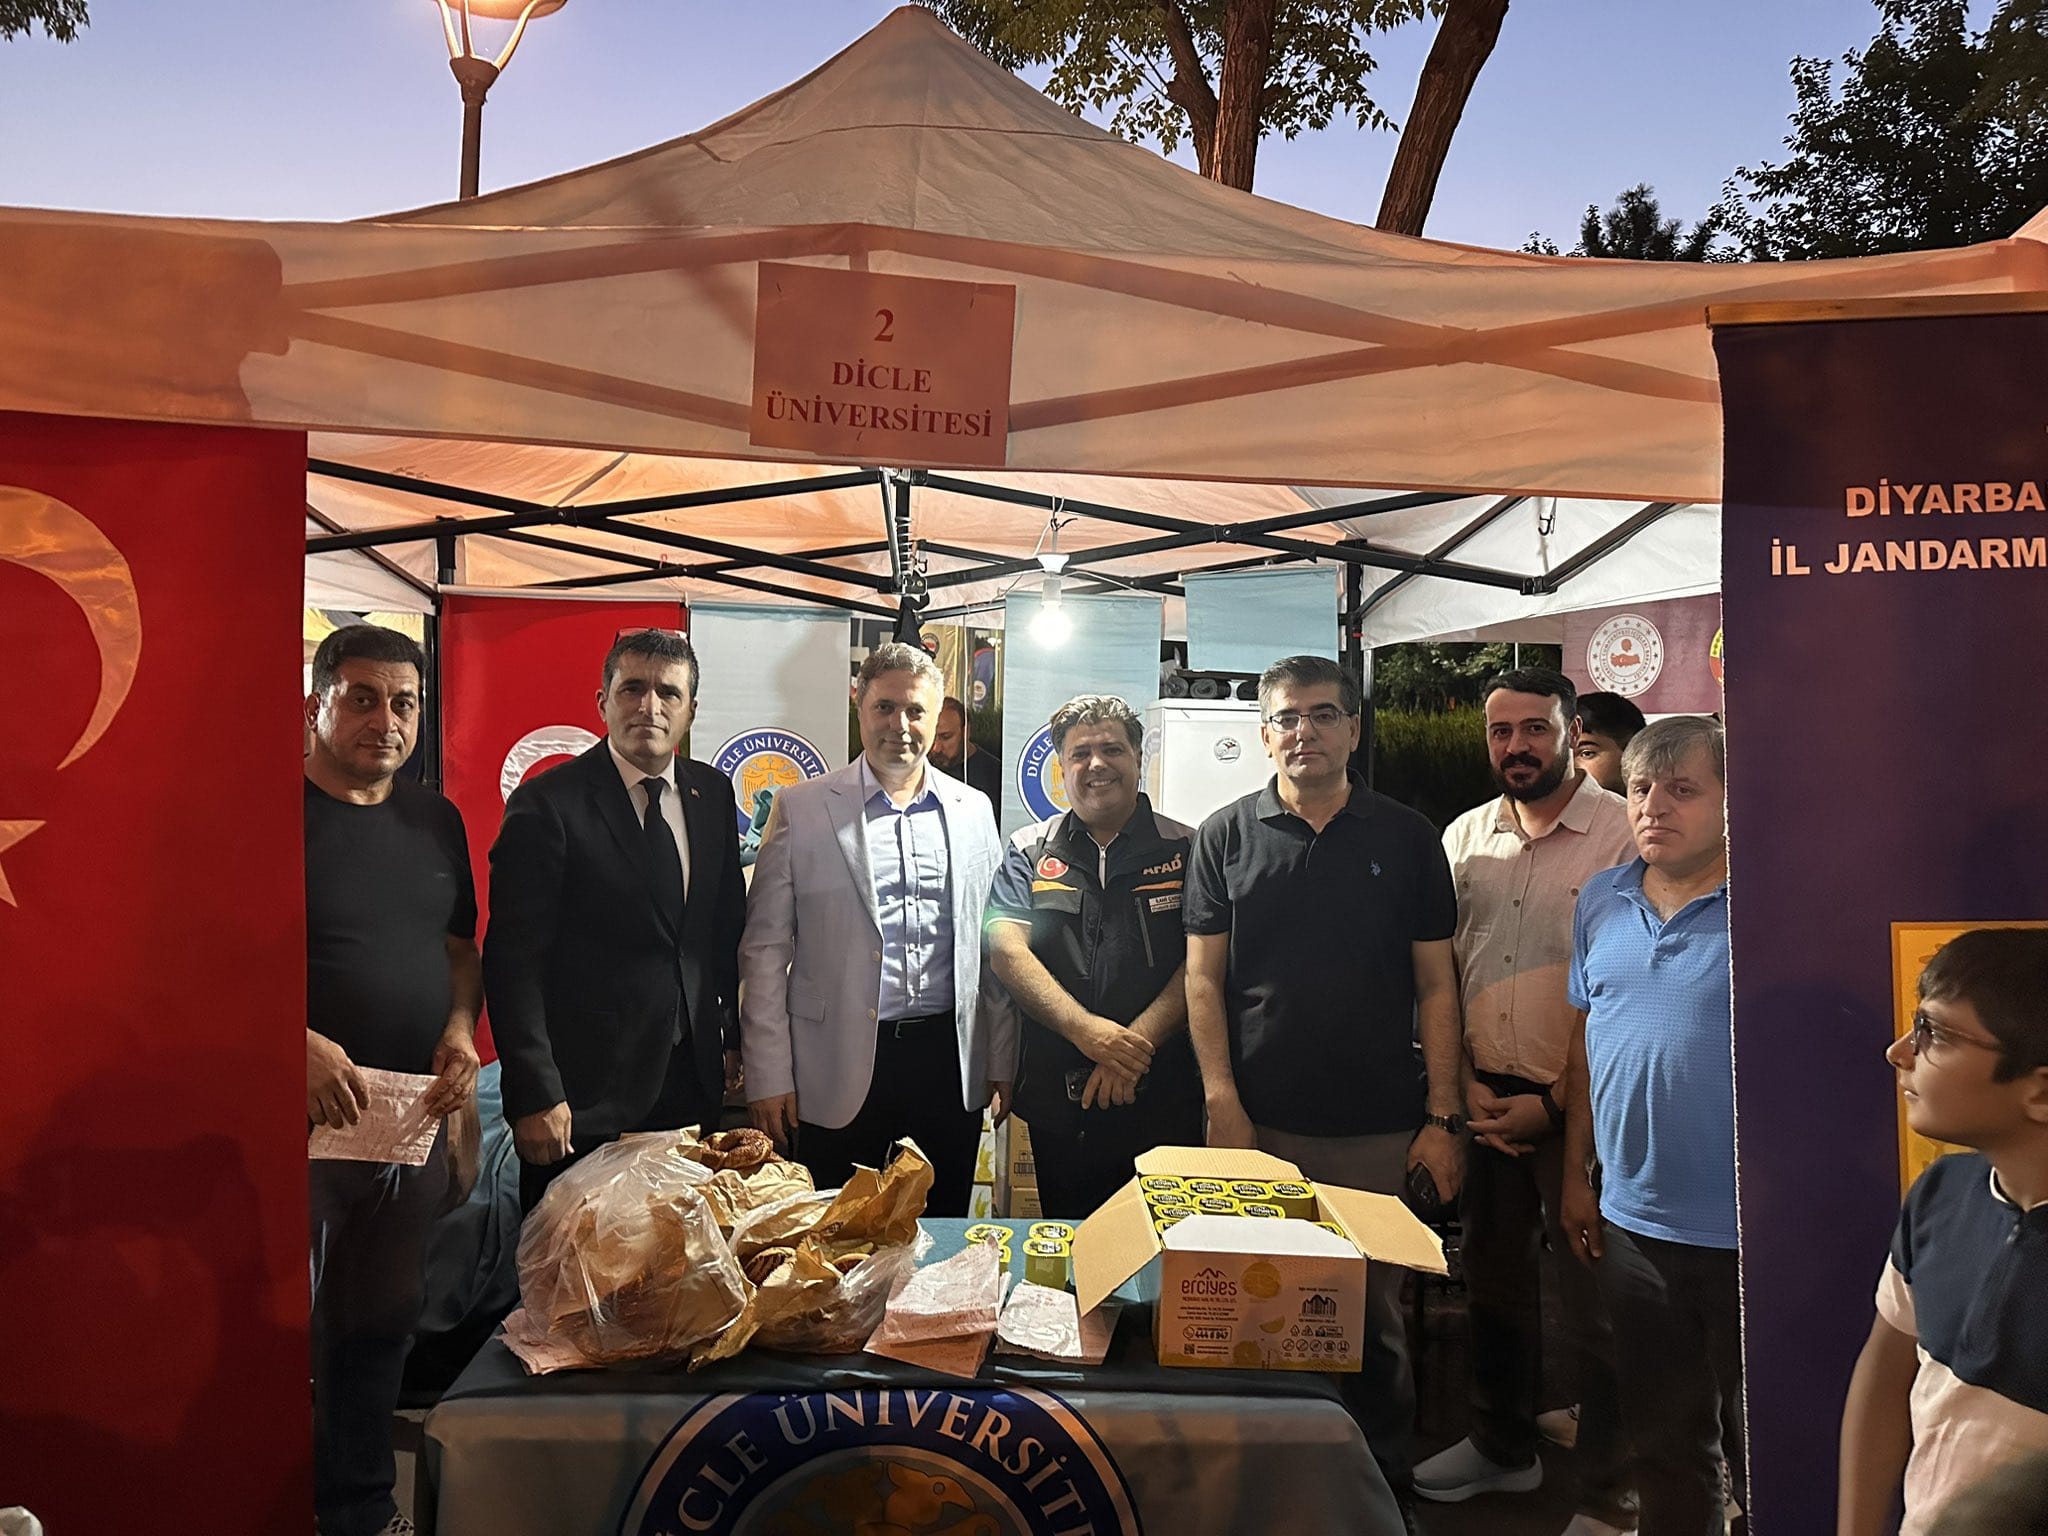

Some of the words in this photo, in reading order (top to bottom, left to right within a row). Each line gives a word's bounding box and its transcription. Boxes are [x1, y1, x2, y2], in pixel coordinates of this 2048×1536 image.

[874, 309, 894, 342] 2
[832, 358, 931, 393] DİCLE
[766, 391, 991, 437] ÜNİVERSİTESİ
[1846, 478, 2046, 517] DİYARBA
[1771, 538, 1810, 576] İL
[1825, 536, 2046, 574] JANDARM
[721, 747, 744, 777] CLE
[743, 735, 820, 778] ÜNİVERSİTE
[1026, 736, 1054, 777] DİCLE
[1181, 1274, 1238, 1296] erciyes
[655, 1430, 768, 1536] CLE
[770, 1386, 1096, 1536] ÜNİVERSİT
